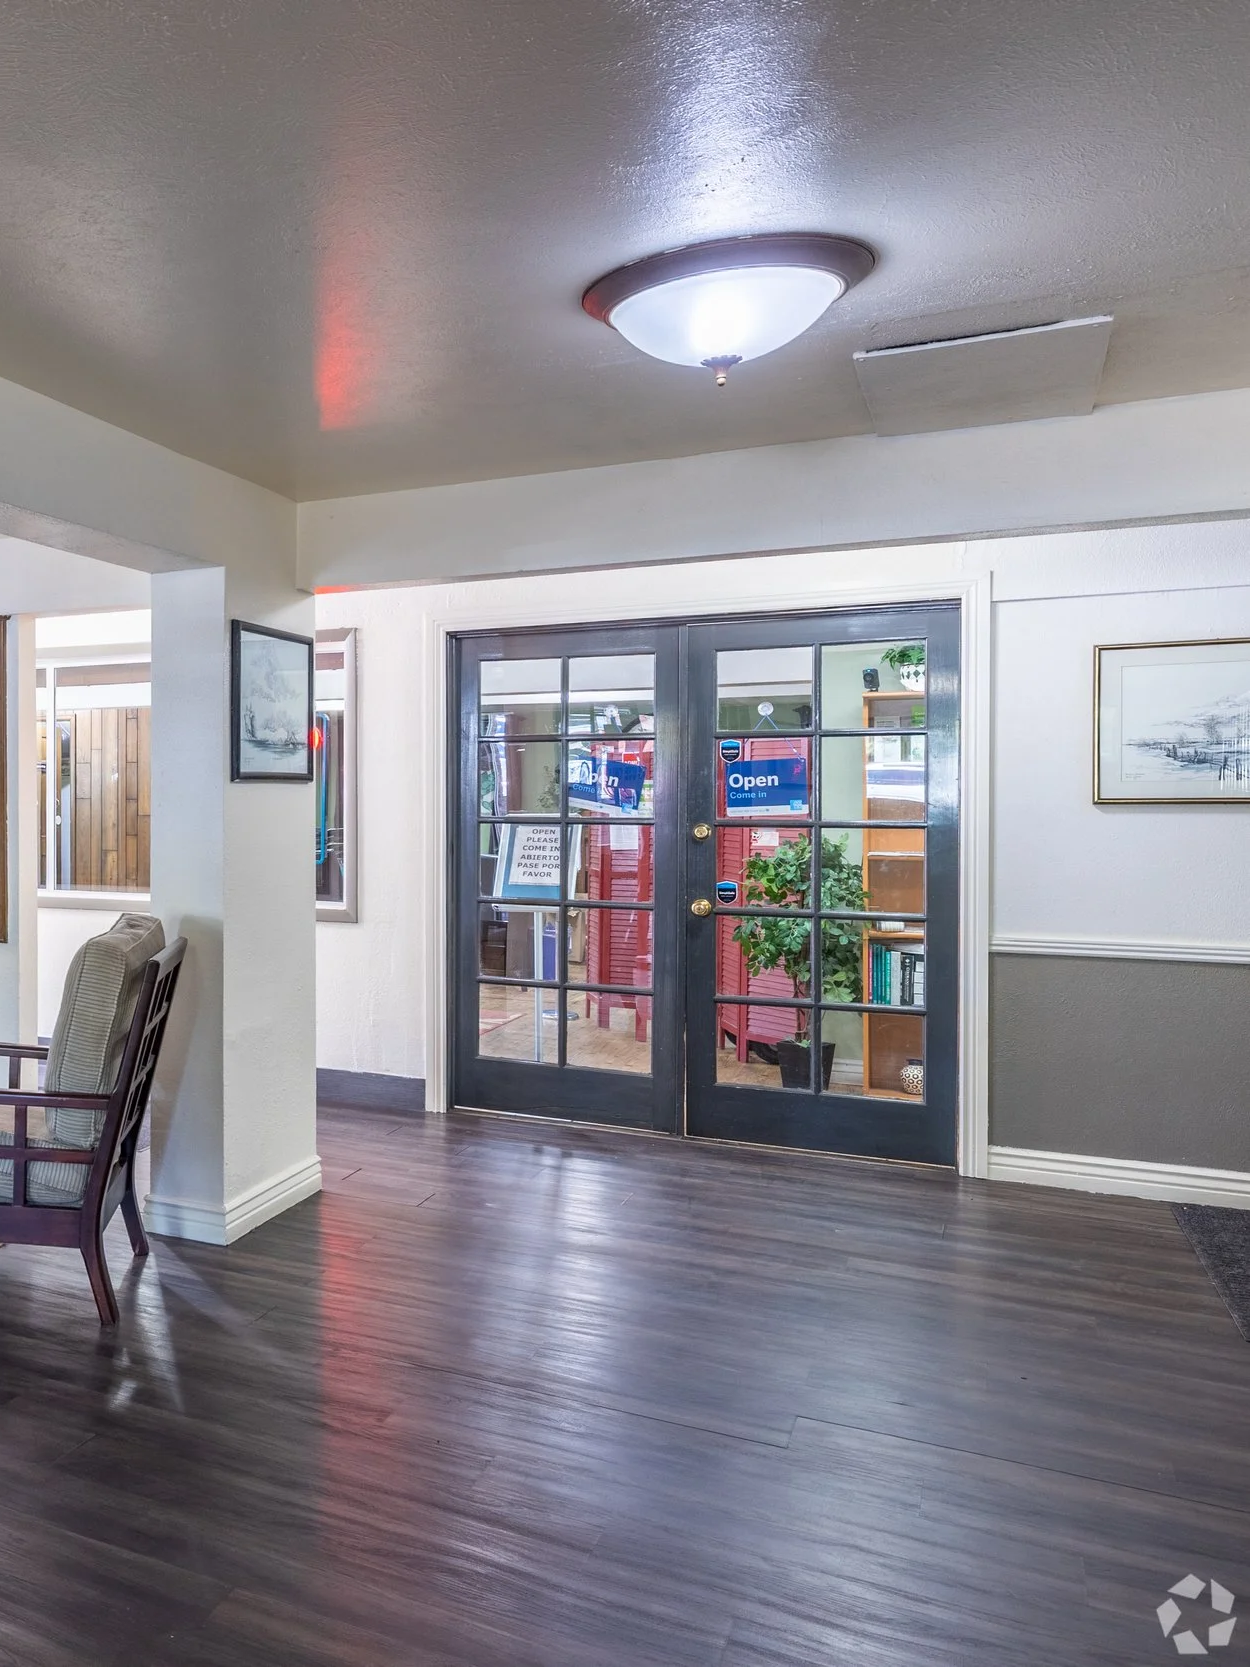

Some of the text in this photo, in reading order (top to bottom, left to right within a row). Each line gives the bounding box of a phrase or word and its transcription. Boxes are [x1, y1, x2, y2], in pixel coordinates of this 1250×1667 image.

[729, 773, 779, 791] Open
[729, 790, 767, 799] Come in
[526, 836, 559, 844] PLEASE
